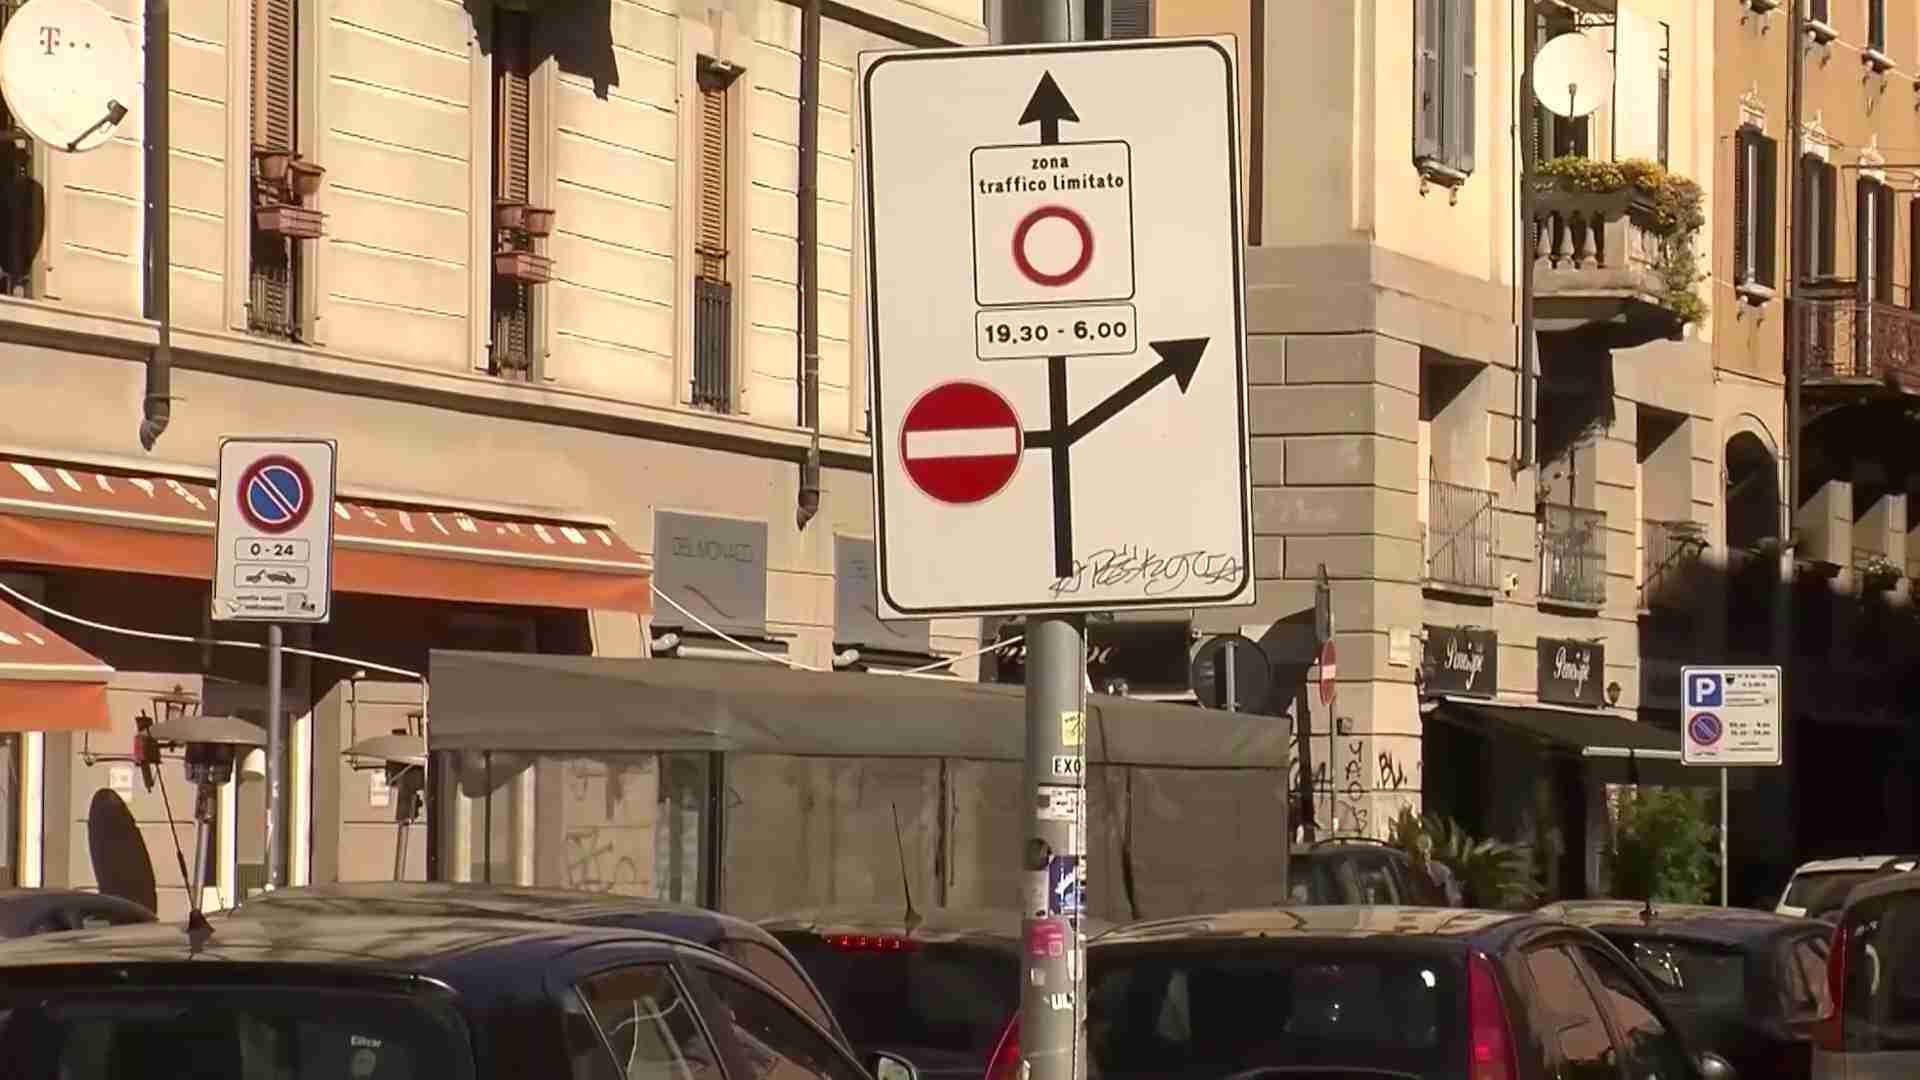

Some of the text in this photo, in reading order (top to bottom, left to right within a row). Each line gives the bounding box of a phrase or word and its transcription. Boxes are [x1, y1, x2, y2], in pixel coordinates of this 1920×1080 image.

[1032, 156, 1069, 170] zona
[979, 173, 1124, 194] traffico limitato
[985, 324, 1049, 344] 19.30
[1073, 321, 1127, 341] 6.00
[274, 544, 294, 556] 24
[1696, 678, 1717, 703] P
